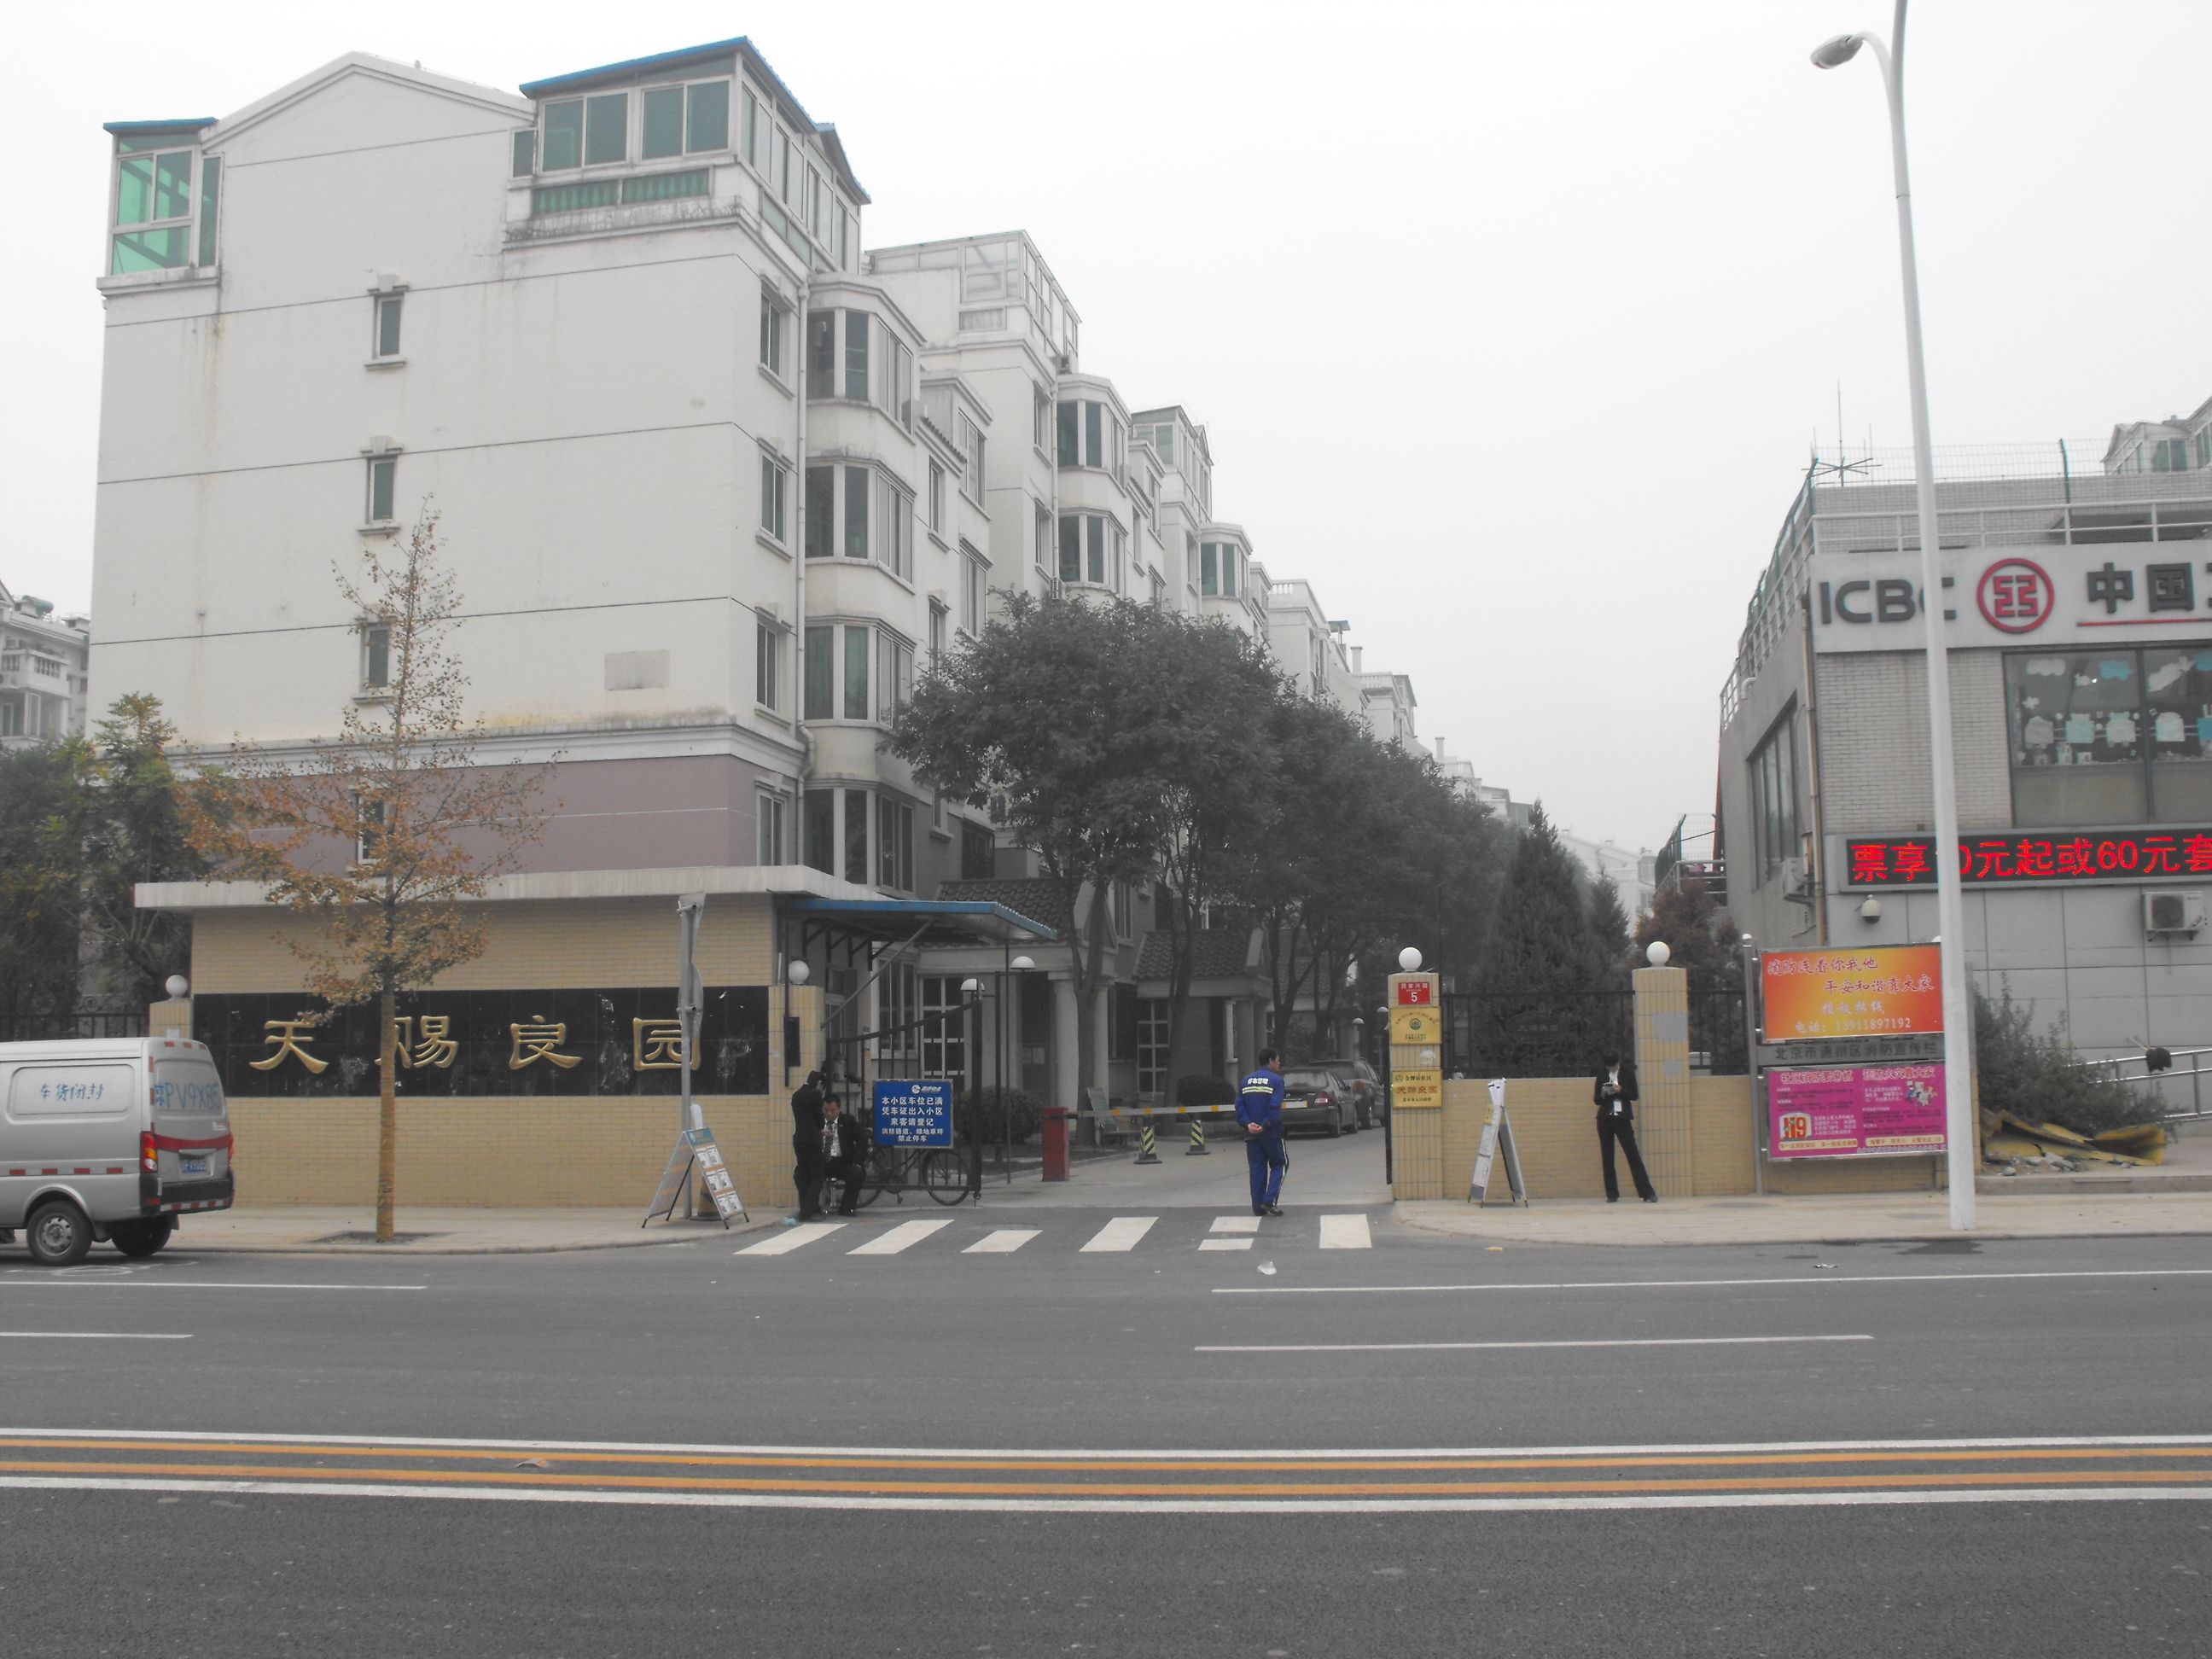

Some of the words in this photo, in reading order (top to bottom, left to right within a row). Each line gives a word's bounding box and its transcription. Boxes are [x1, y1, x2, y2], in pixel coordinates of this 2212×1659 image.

[2087, 562, 2212, 614] 中国
[1851, 834, 2212, 882] 票享0元起或60元套
[1767, 957, 1878, 976] 消防连着你我他
[1825, 974, 1935, 995] 平安和谐靠大家
[1411, 992, 1417, 1003] 5
[1775, 1042, 1937, 1060] 北京市通州区消防宣传栏
[882, 1097, 943, 1105] 本小区车位已满
[882, 1107, 943, 1115] 凭车证出入小区
[890, 1117, 934, 1126] 来客请登记
